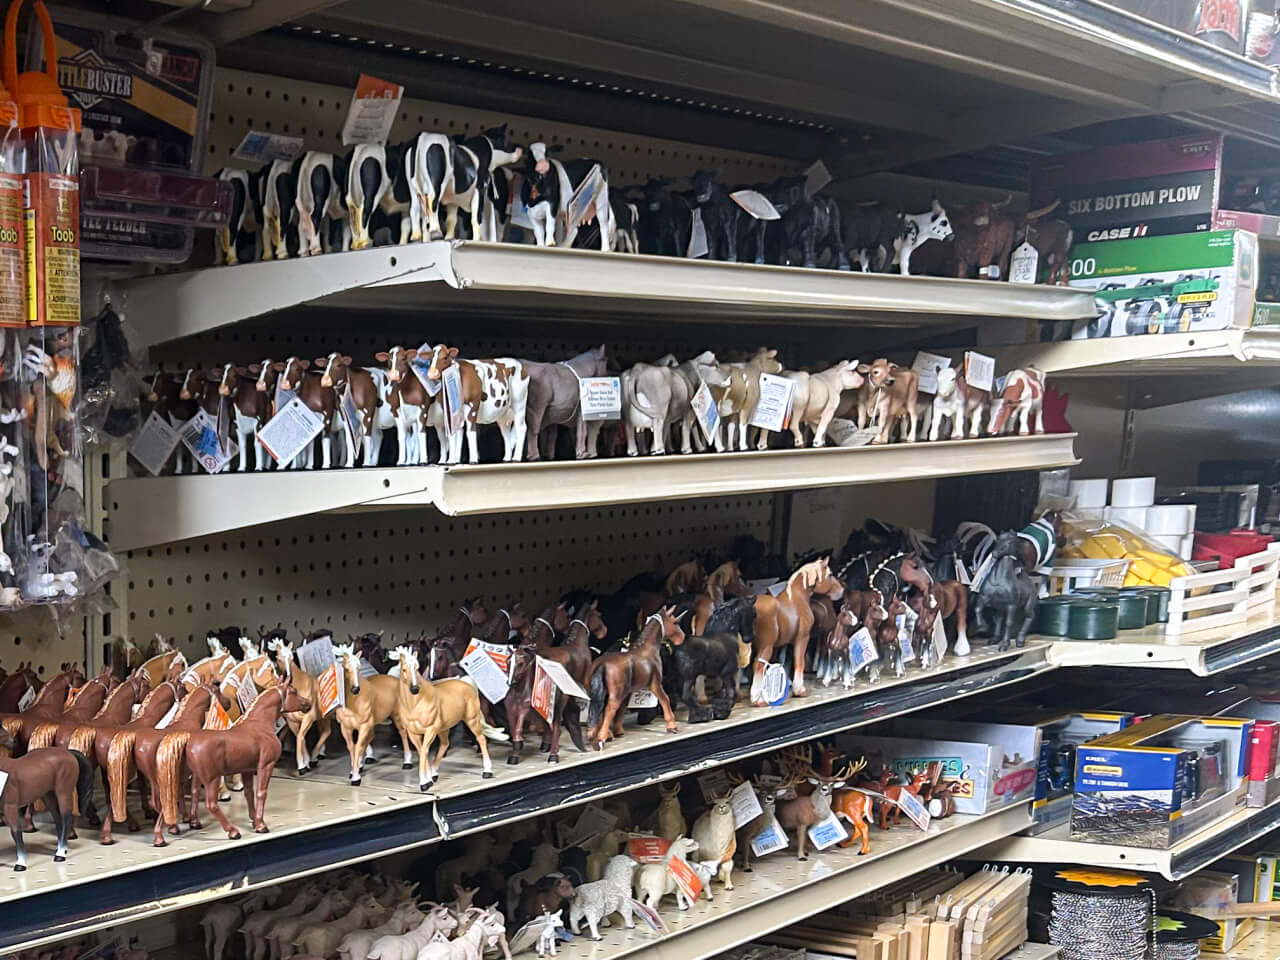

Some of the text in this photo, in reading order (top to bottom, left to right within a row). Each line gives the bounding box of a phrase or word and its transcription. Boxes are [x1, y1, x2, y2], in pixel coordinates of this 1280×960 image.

[1070, 185, 1201, 214] SIX BOTTOM PLOW
[51, 226, 75, 243] Toob
[1088, 228, 1131, 241] CASE
[1072, 258, 1096, 276] 00
